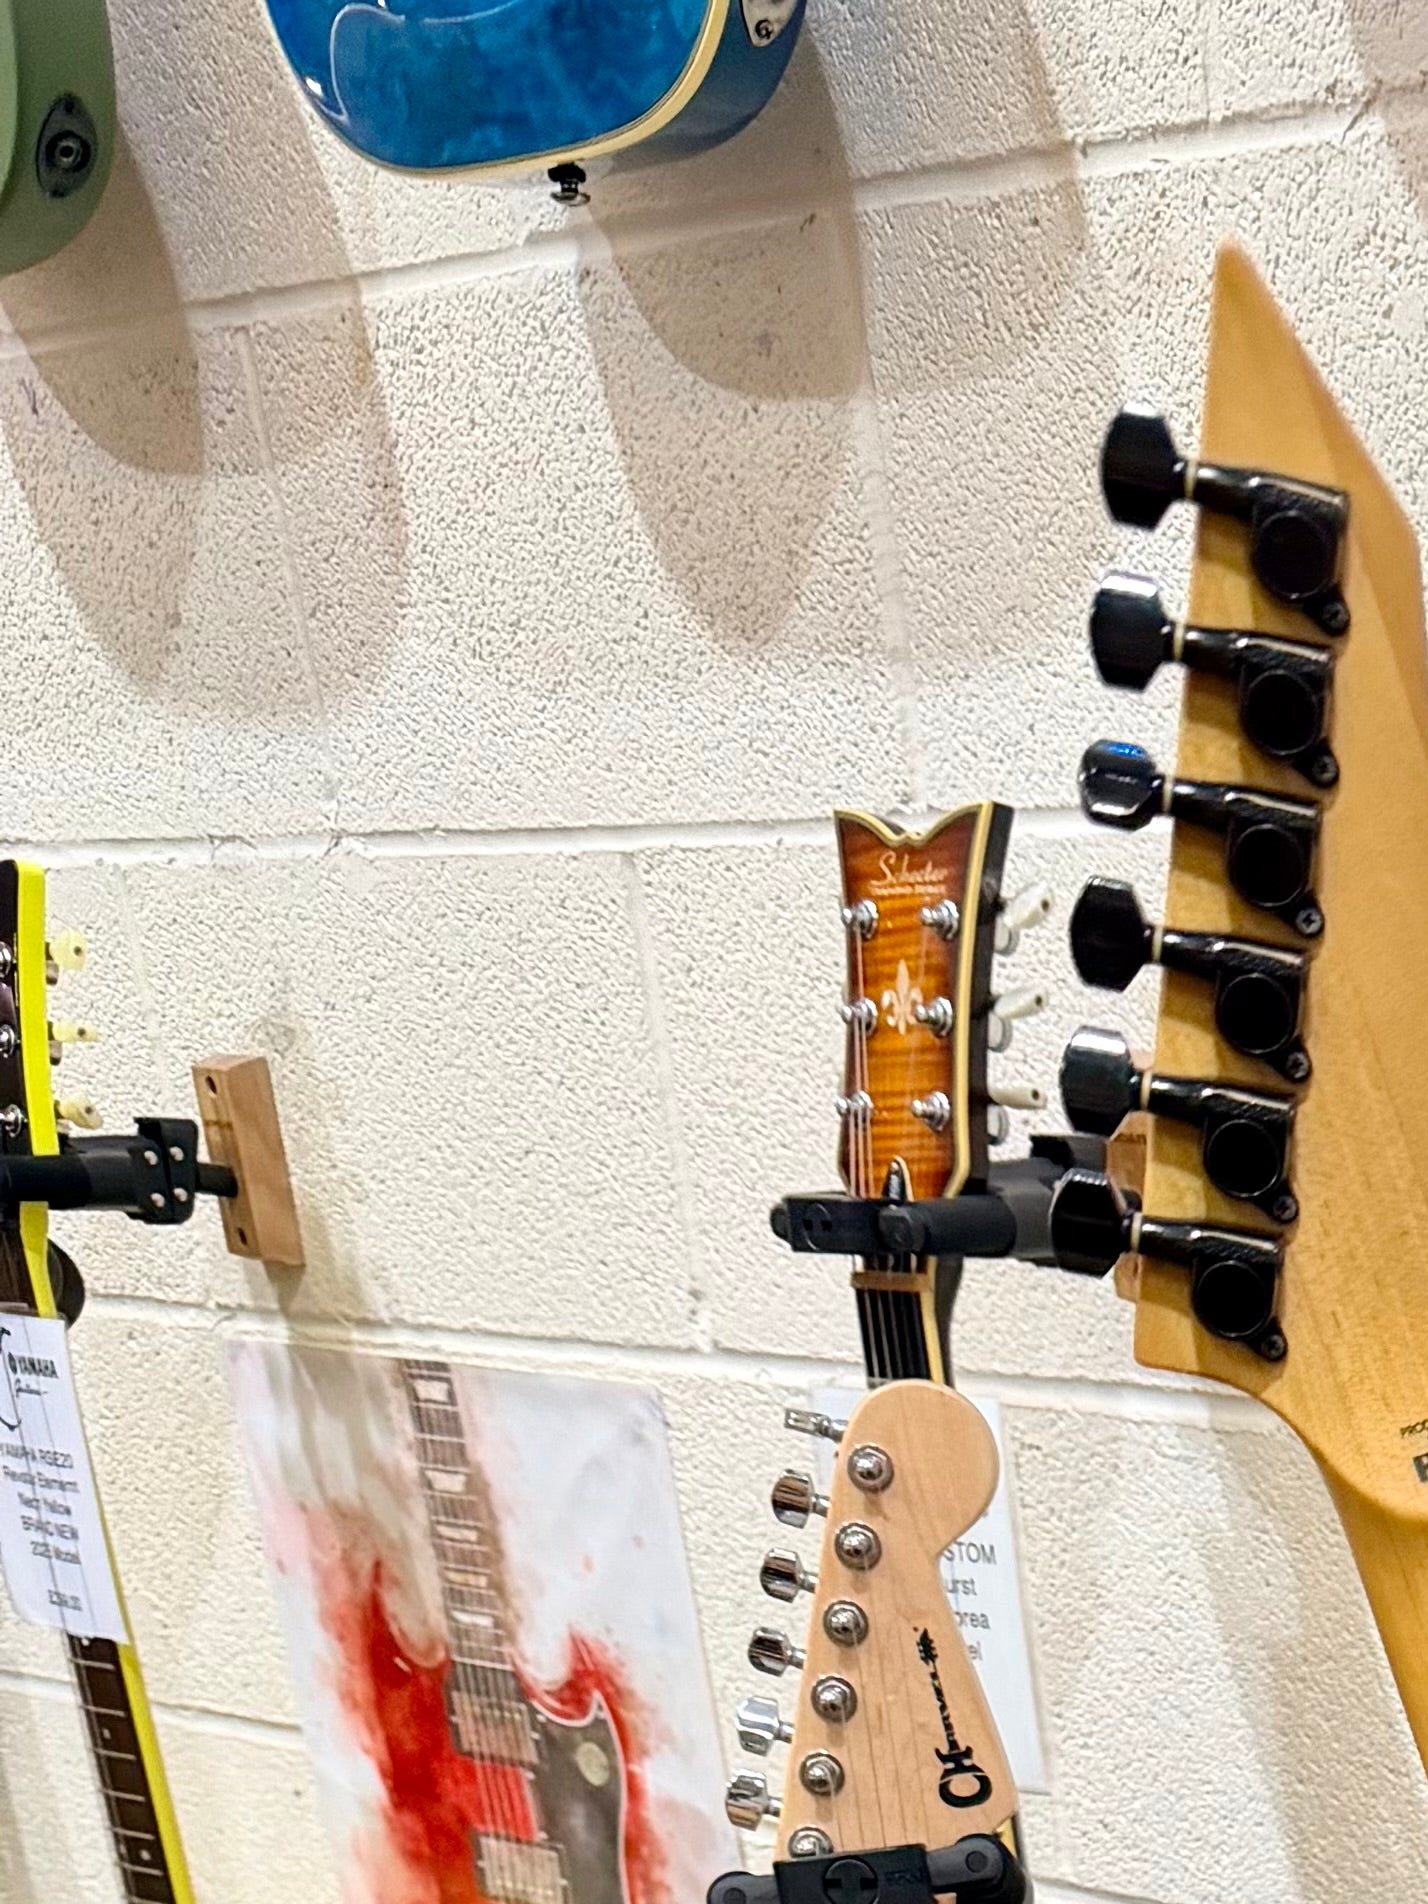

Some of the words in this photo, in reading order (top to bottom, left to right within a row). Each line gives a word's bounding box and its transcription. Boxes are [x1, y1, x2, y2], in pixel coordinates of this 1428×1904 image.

[869, 851, 949, 886] Schecter
[17, 1355, 59, 1379] YAMAHA
[944, 1541, 998, 1566] STOM
[945, 1577, 978, 1597] urst
[954, 1610, 991, 1631] orea
